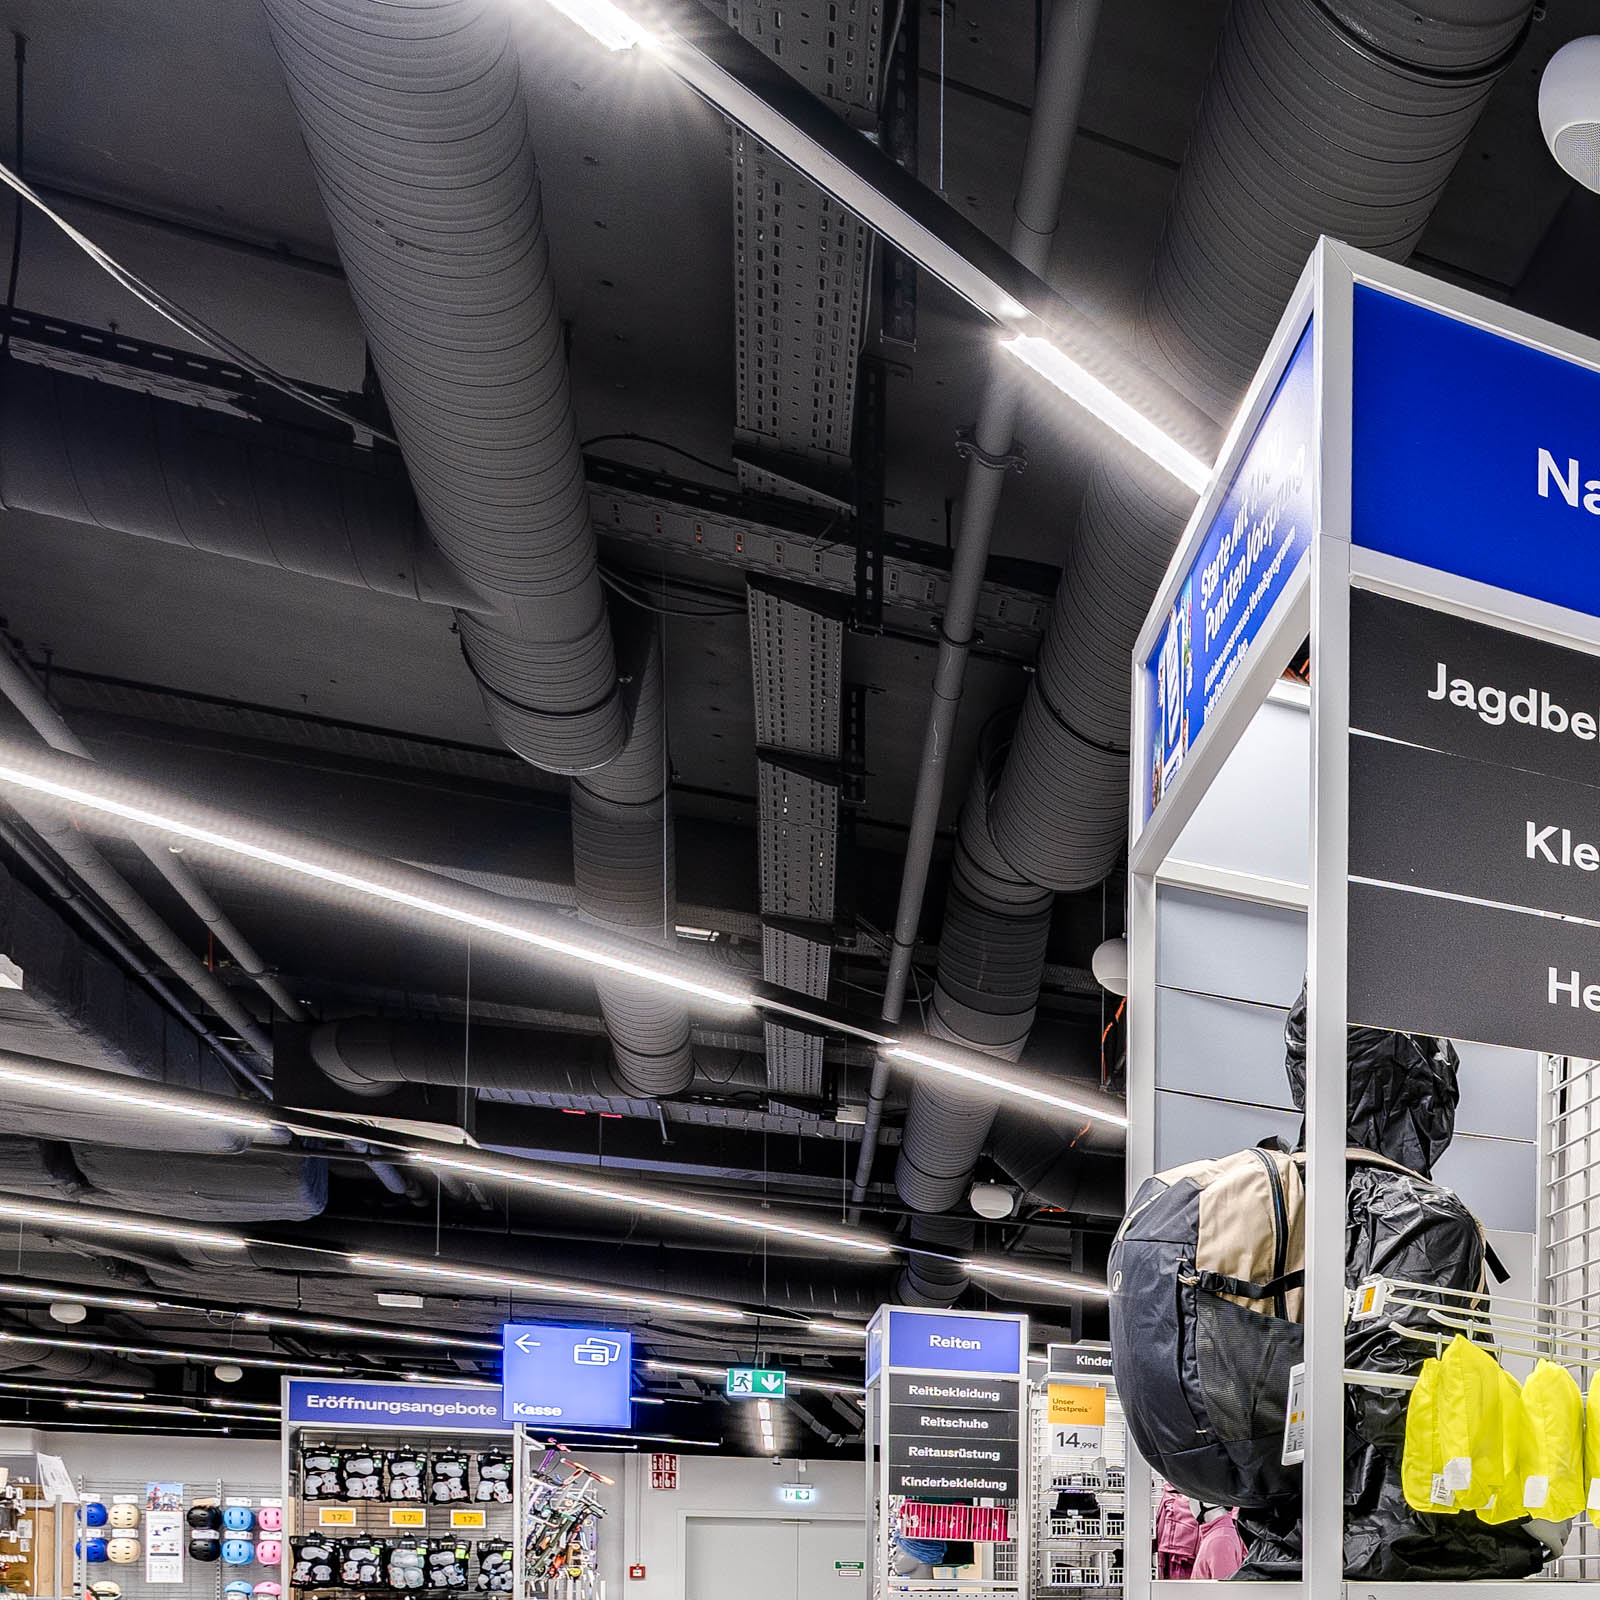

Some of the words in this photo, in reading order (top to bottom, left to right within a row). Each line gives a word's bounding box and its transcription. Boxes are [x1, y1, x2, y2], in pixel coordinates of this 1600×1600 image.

[1200, 532, 1230, 611] Starte
[1205, 555, 1246, 653] Punkten
[929, 1334, 982, 1350] Reiten
[1076, 1355, 1112, 1367] Kinder
[908, 1384, 1001, 1402] Reitbekleidung
[1052, 1397, 1075, 1405] Unser
[306, 1394, 499, 1417] Eröffnungsangebote
[513, 1402, 563, 1418] Kasse
[1052, 1405, 1089, 1413] Bestpreis
[920, 1415, 989, 1430] Reitschuhe
[908, 1445, 1001, 1462] Reitausrüstung
[901, 1475, 1008, 1493] Kinderbekleidung
